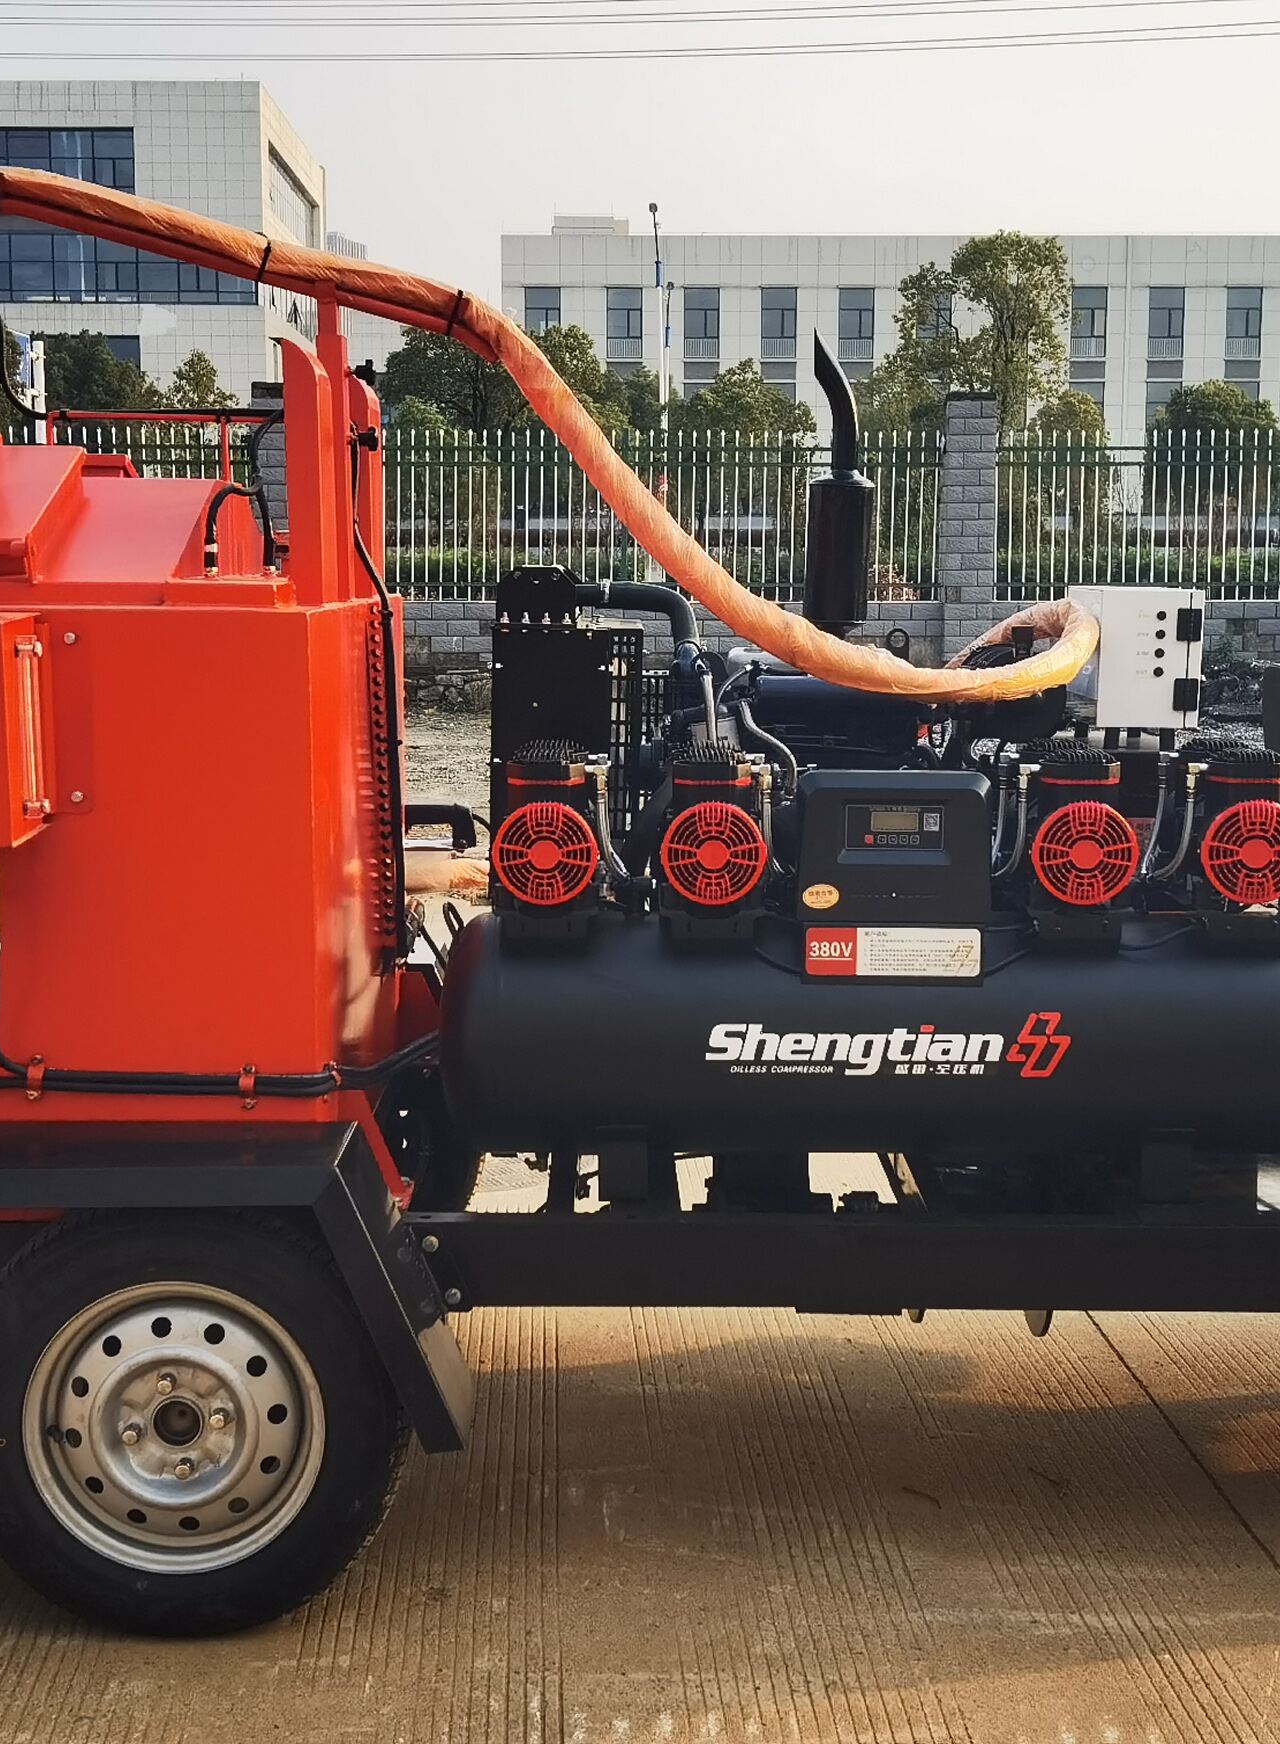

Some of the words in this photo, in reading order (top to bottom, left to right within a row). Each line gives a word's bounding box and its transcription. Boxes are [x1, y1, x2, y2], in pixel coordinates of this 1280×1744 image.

[809, 940, 853, 958] 380V
[705, 1023, 1004, 1077] Shengtian
[730, 1065, 767, 1074] OILLESS
[770, 1065, 834, 1074] COMPRESSOR
